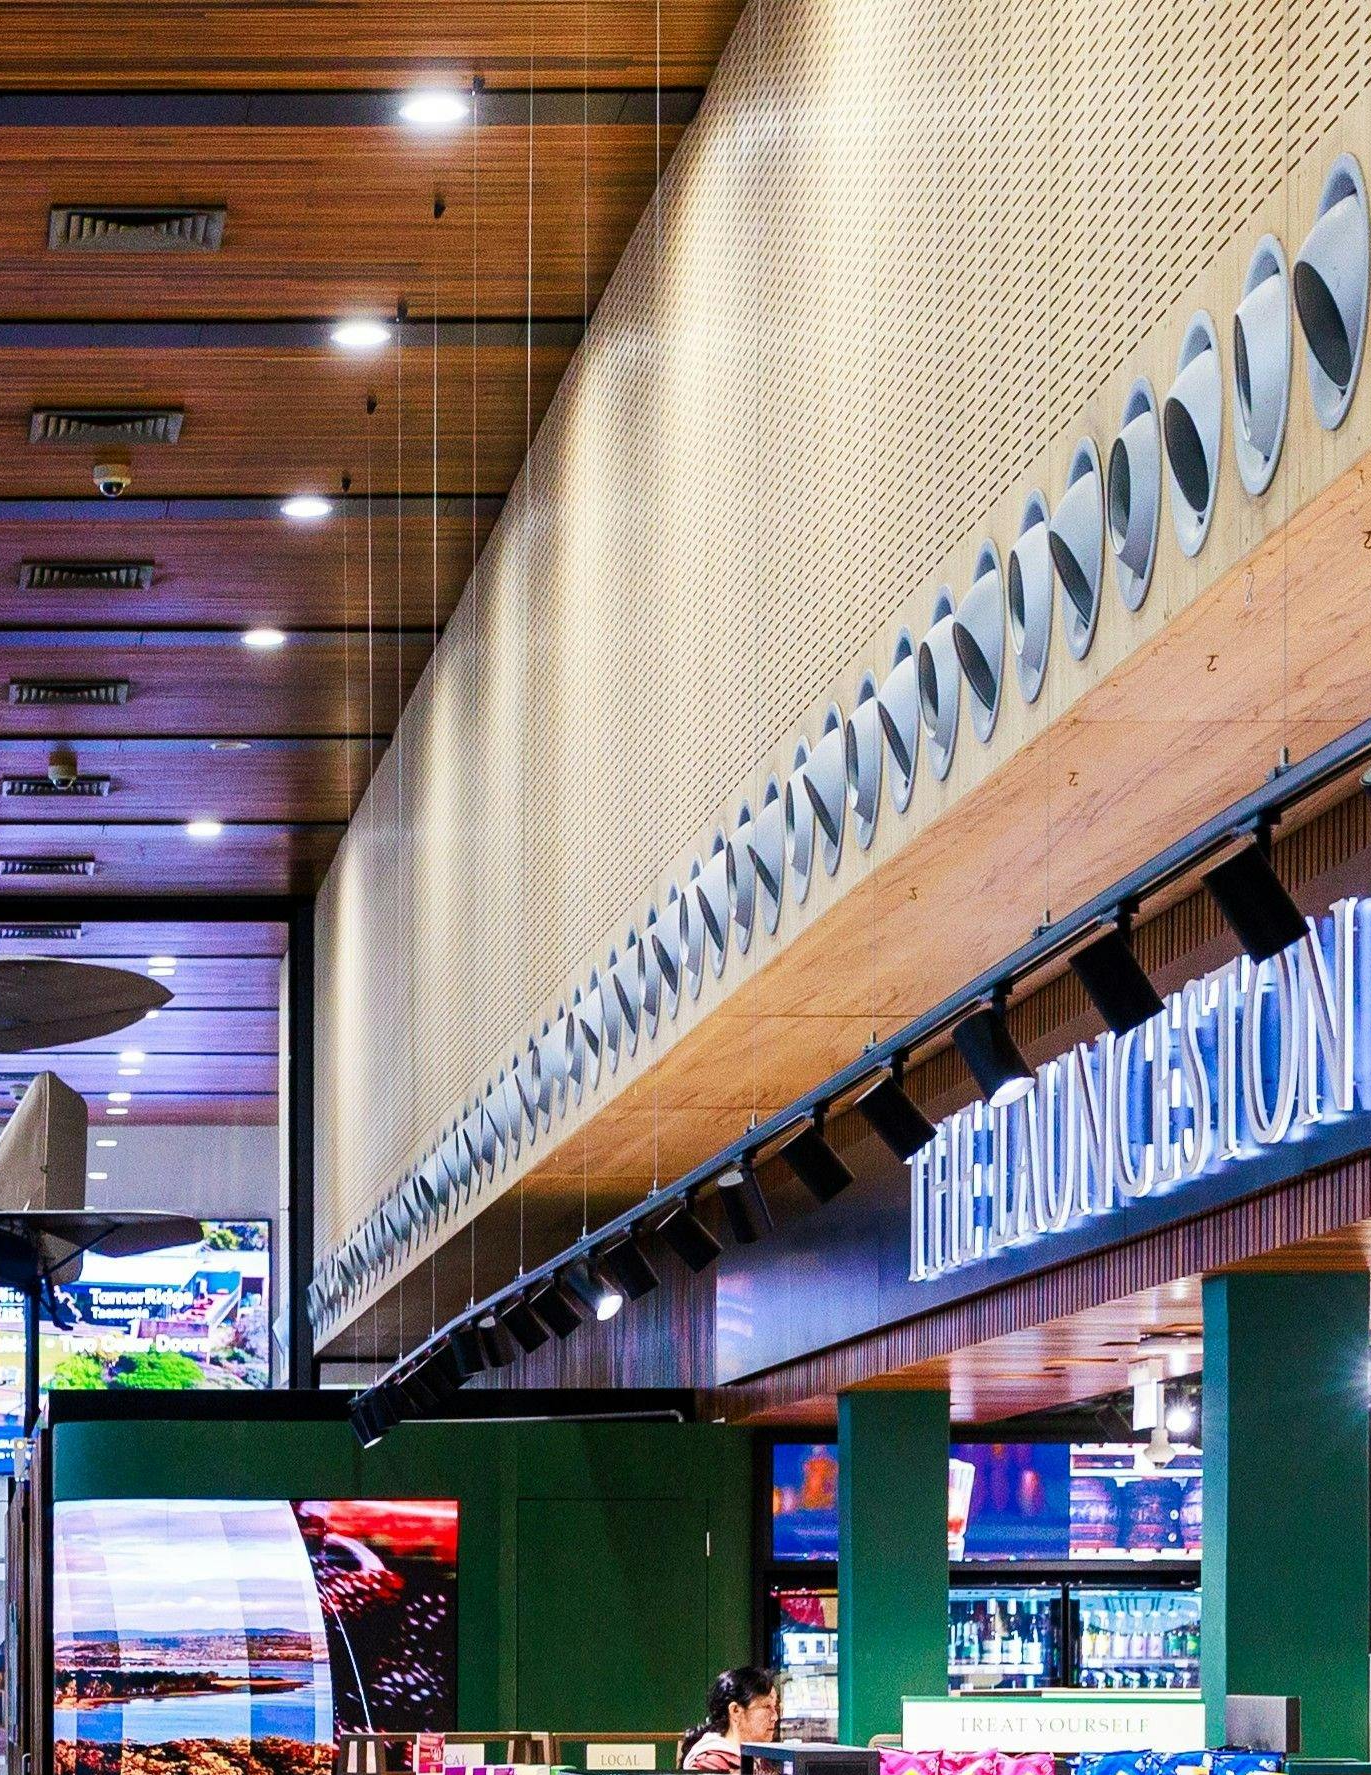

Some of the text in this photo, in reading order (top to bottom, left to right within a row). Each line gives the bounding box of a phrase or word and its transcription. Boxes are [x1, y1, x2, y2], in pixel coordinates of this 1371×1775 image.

[903, 1100, 984, 1282] THE
[988, 897, 1358, 1250] LAUNCESTON
[60, 1335, 97, 1352] Two
[156, 1334, 212, 1352] Doors
[960, 1717, 1151, 1734] TREAT YOURSELF
[601, 1753, 639, 1766] LOCAL
